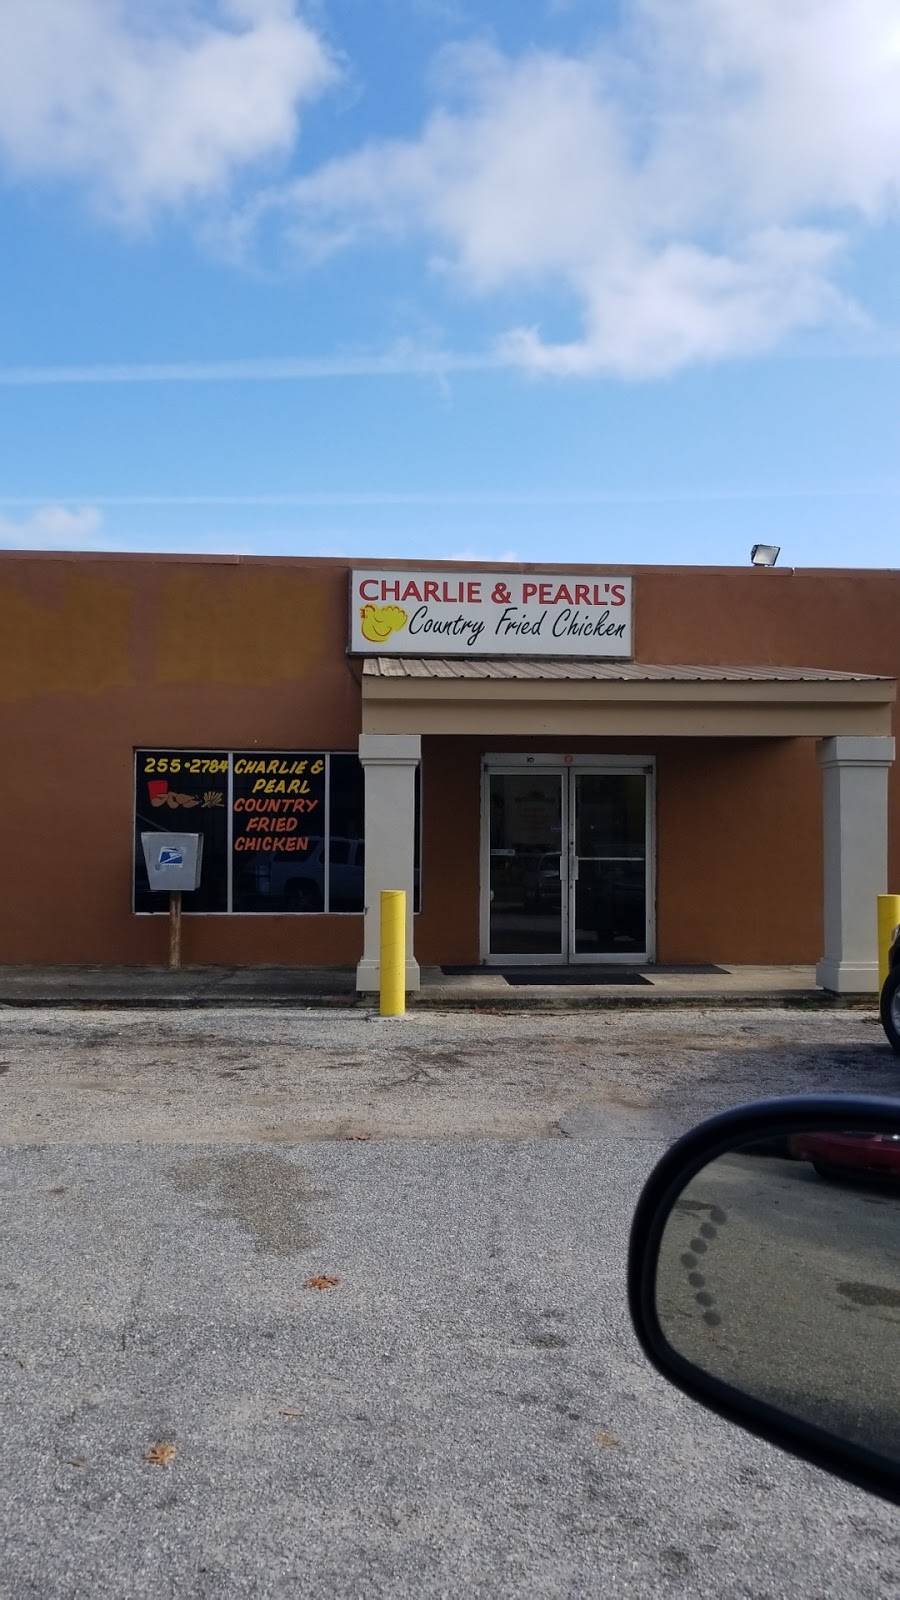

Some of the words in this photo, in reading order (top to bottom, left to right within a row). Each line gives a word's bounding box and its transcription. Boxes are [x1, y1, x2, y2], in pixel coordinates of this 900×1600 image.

[359, 580, 482, 603] CHARLIE
[491, 582, 512, 604] &
[522, 583, 626, 606] PEARL'S
[408, 605, 485, 646] Country
[495, 607, 547, 637] Fried
[552, 608, 626, 639] Chicken
[234, 759, 306, 774] CHARLIE
[310, 759, 324, 774] &
[252, 779, 311, 794] PEARL
[234, 798, 318, 813] COUNTRY
[246, 817, 298, 832] FRIED
[234, 836, 309, 852] CHICKEN
